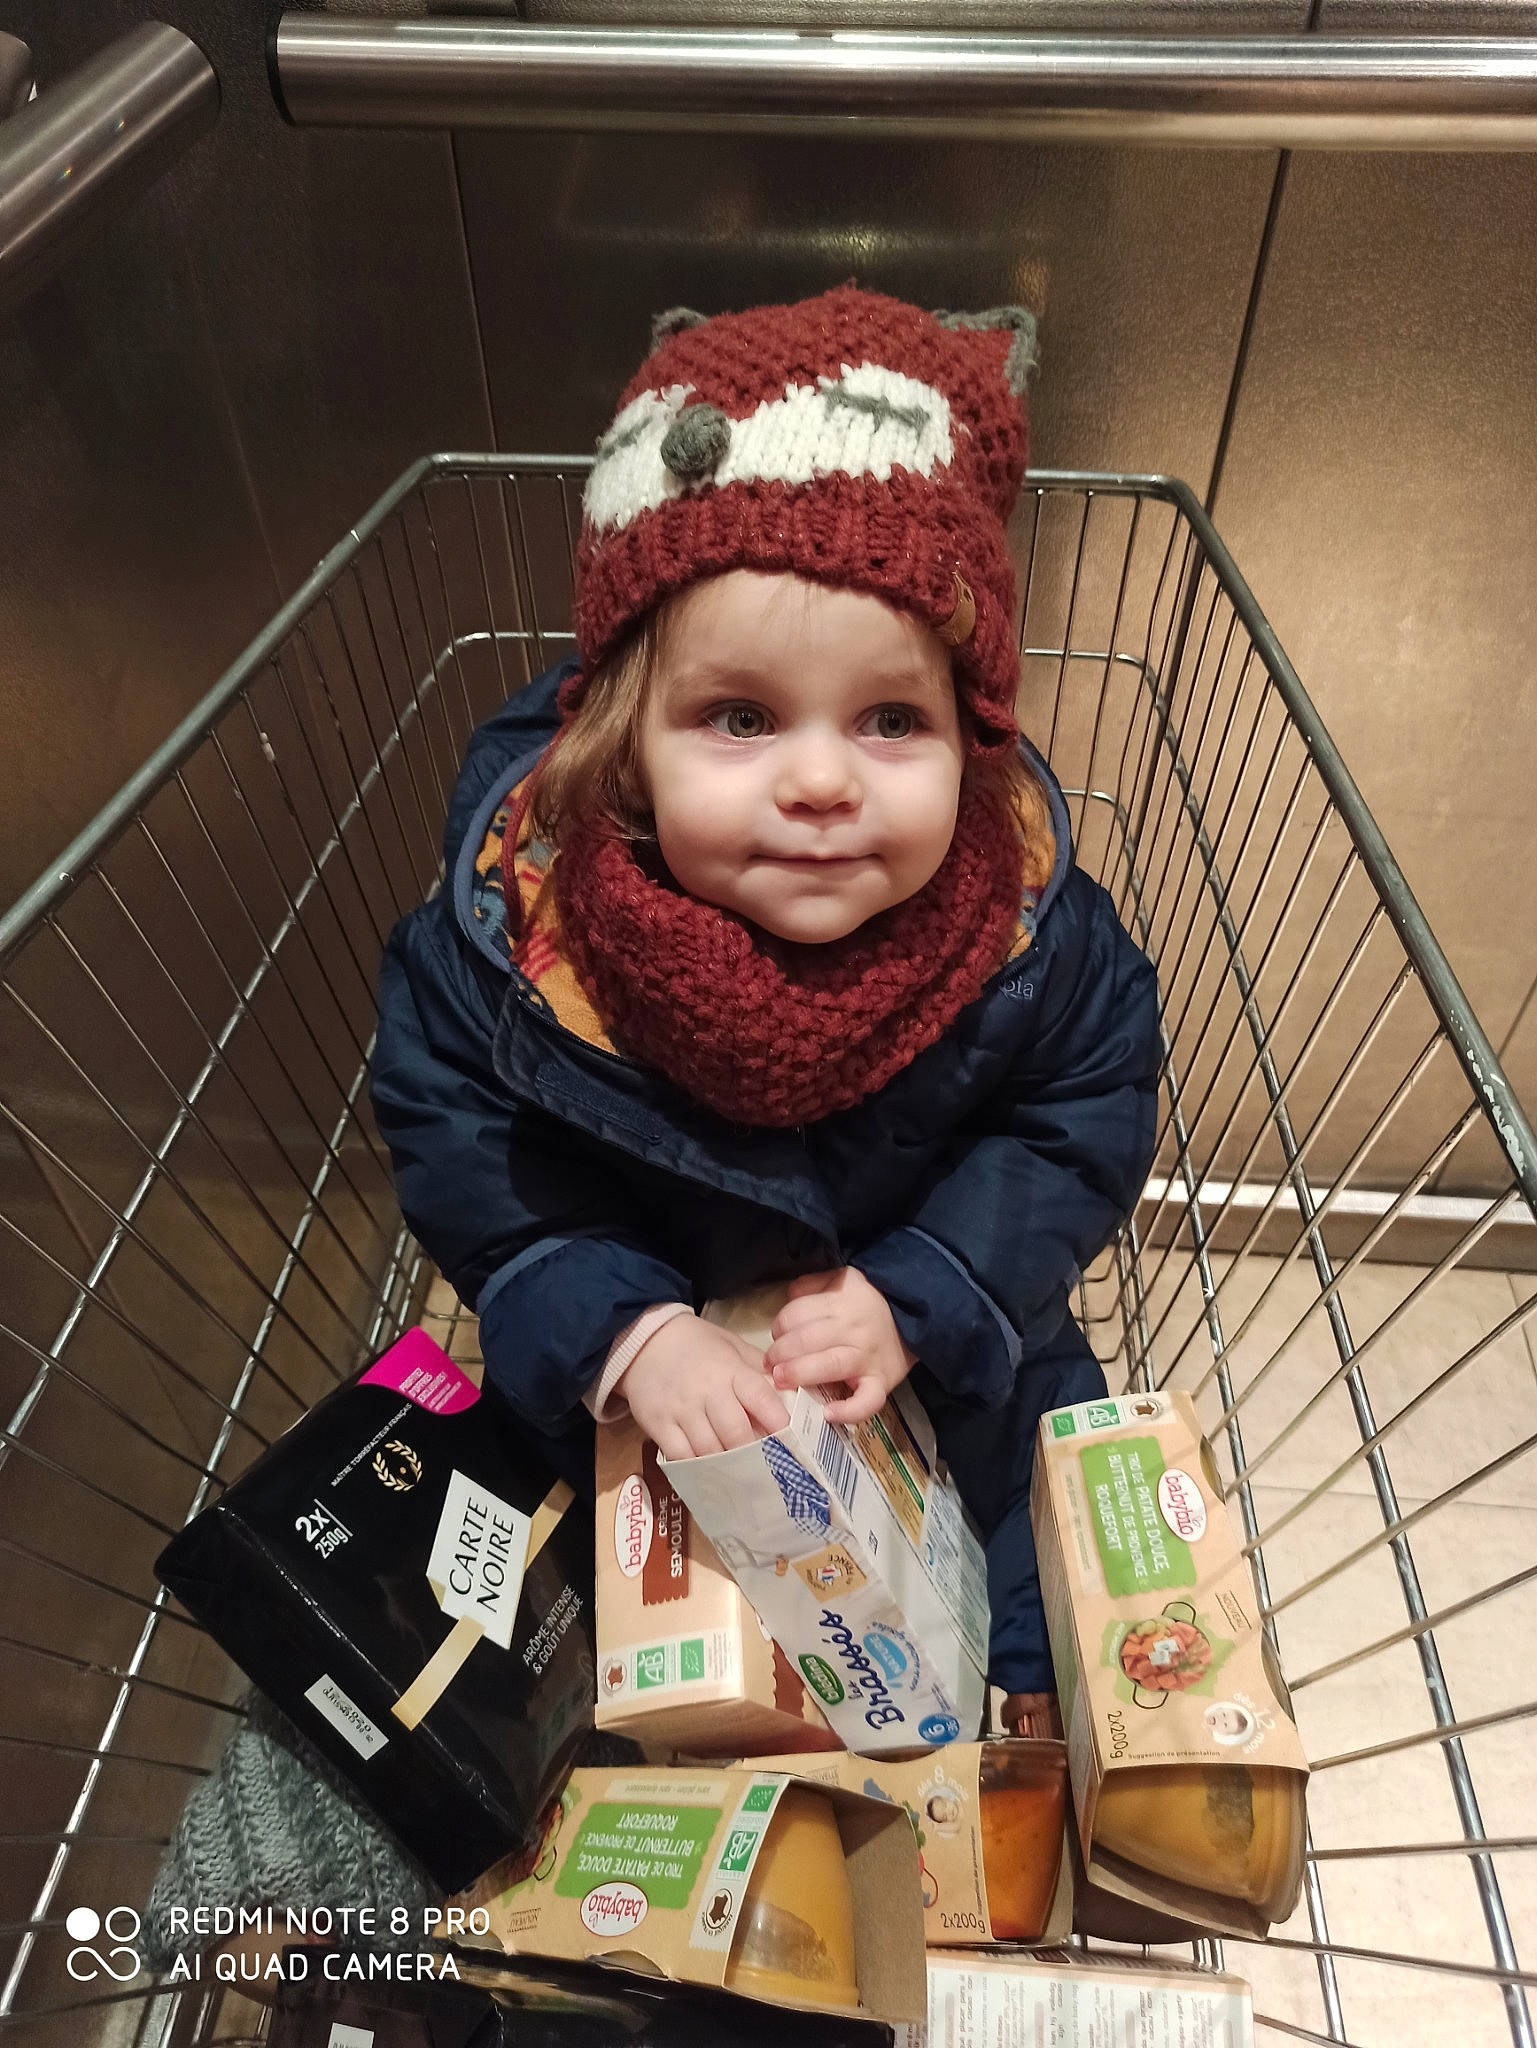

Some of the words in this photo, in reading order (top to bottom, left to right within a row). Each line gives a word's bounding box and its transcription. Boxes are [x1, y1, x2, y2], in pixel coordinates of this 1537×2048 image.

[658, 1497, 668, 1536] CRÈME
[1095, 1484, 1122, 1552] ROQUEFORT
[1108, 1454, 1133, 1514] BUTTERNUT
[1126, 1530, 1147, 1578] PROVENCE
[1136, 1485, 1158, 1526] PATATE
[1165, 1475, 1196, 1535] babybio
[315, 1525, 350, 1560] 250g
[625, 1485, 646, 1568] babybio
[671, 1506, 682, 1577] SEMOULE
[448, 1496, 488, 1596] CARTE
[477, 1517, 515, 1614] NOIRE
[523, 1624, 550, 1667] ARÔME
[544, 1583, 575, 1627] INTENSE
[530, 1662, 544, 1675] &
[556, 1595, 584, 1634] UNIQUE
[818, 1610, 906, 1732] Brassés
[927, 1722, 947, 1739] 6
[1107, 1710, 1128, 1759] 2x200g
[935, 1766, 944, 1783] 8
[616, 1812, 678, 1831] ROQUEFORT
[584, 1832, 624, 1847] PROVENCE
[624, 1836, 636, 1848] DE
[634, 1836, 695, 1856] BUTTERNUT
[728, 1832, 755, 1860] AB
[577, 1851, 613, 1872] DOUCE,
[614, 1858, 651, 1877] PATATE
[651, 1861, 664, 1874] DE
[664, 1863, 683, 1877] TRIO
[587, 1891, 643, 1923] babybio
[941, 1913, 985, 1933] 2x200g
